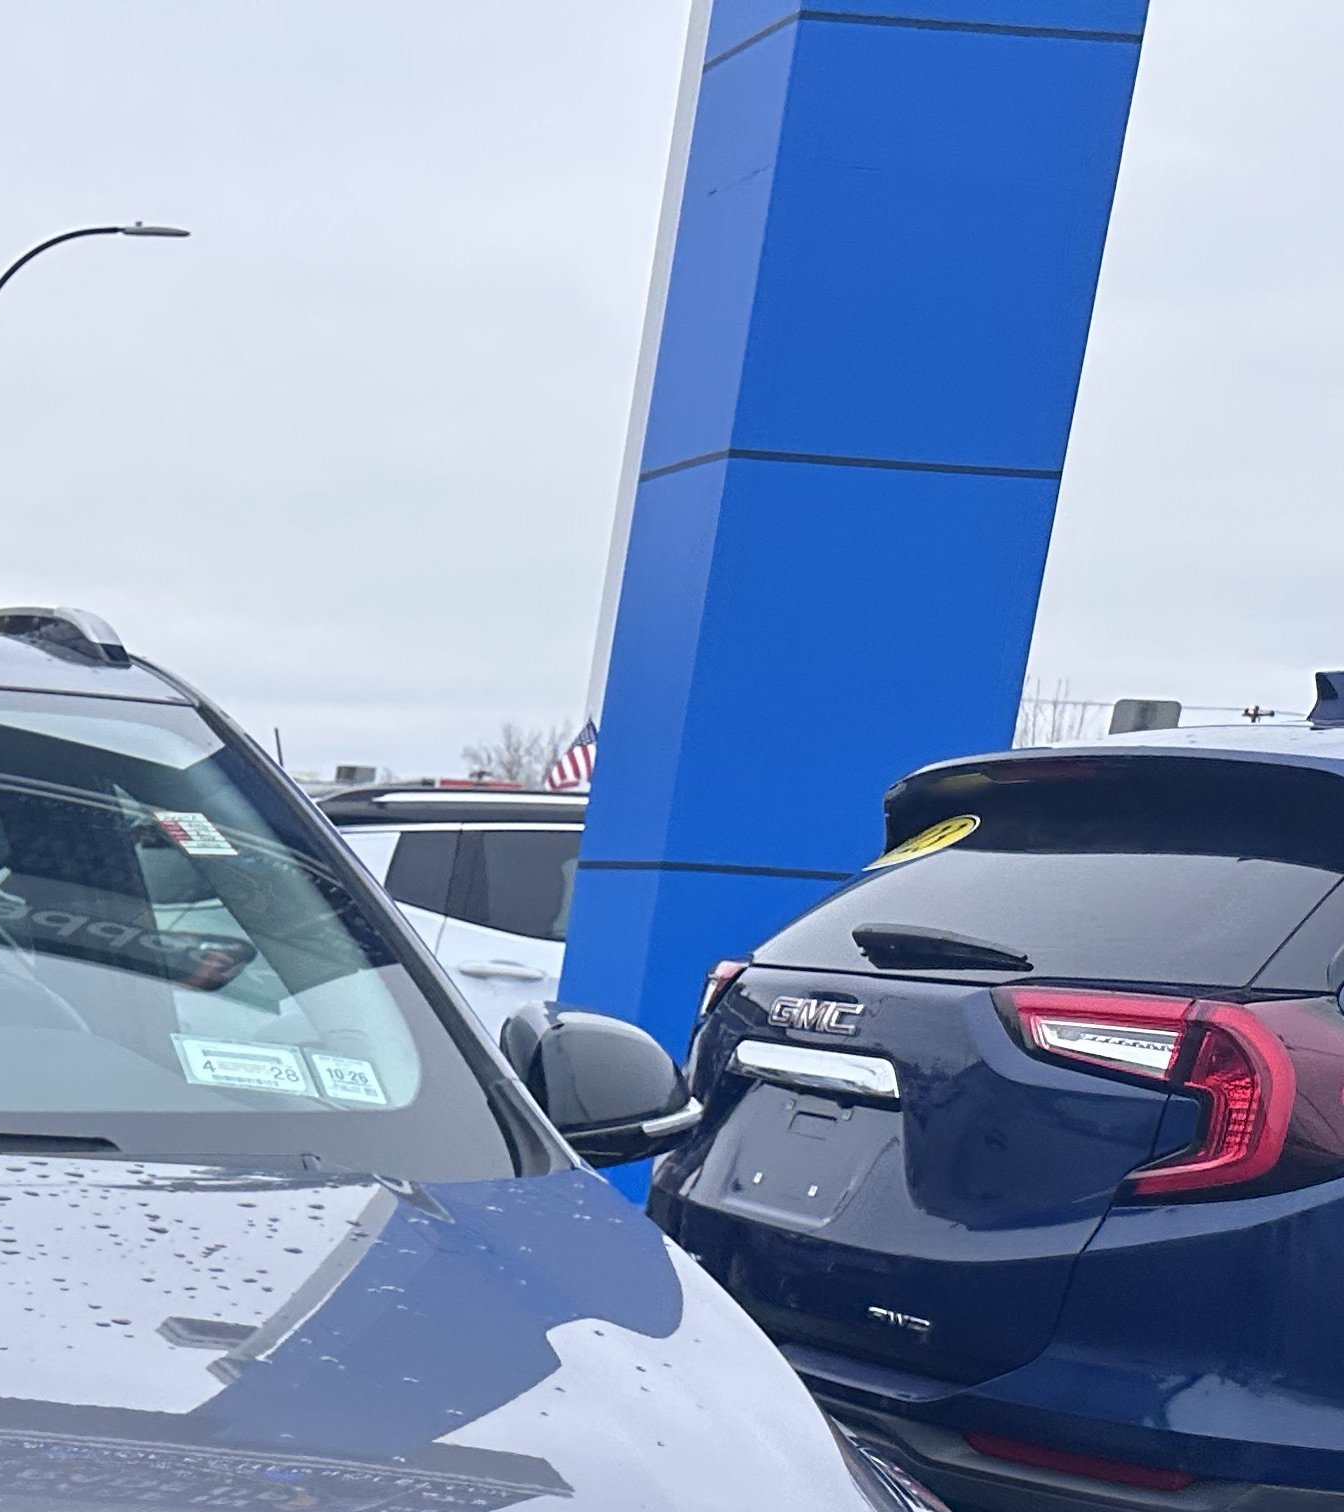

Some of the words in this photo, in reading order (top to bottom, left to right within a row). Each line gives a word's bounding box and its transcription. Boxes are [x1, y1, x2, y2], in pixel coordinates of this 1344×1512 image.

[768, 996, 864, 1036] GMC
[203, 1060, 216, 1073] 4
[270, 1066, 300, 1082] 28
[326, 1067, 344, 1081] 10
